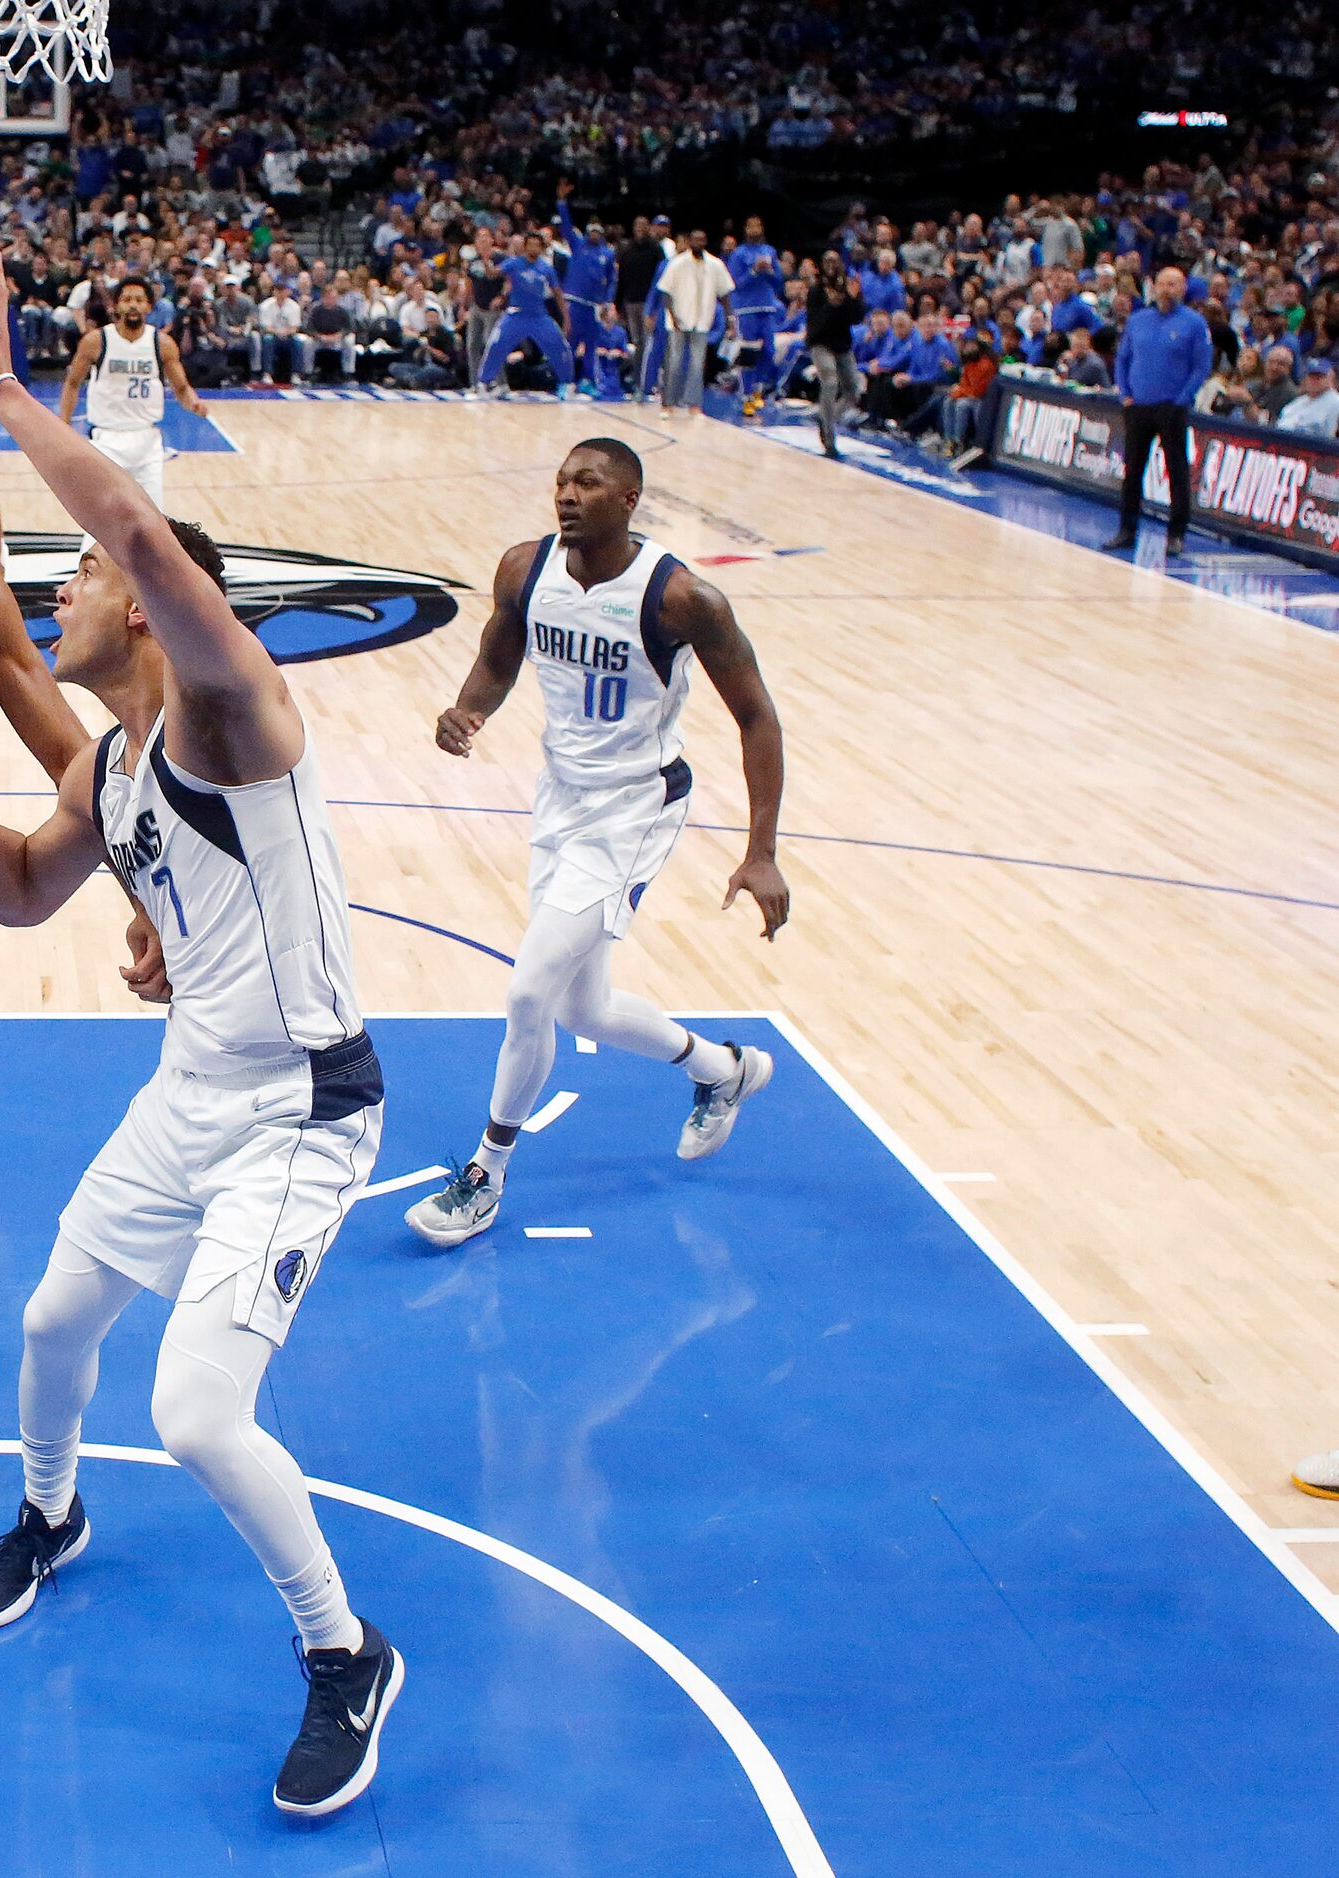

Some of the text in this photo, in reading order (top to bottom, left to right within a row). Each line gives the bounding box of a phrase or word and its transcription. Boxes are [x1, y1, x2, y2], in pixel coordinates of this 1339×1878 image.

[128, 377, 150, 398] 26
[1213, 444, 1307, 528] PLAYOFFS
[601, 602, 636, 618] chime
[534, 622, 630, 671] DALLAS
[582, 671, 628, 722] 10
[151, 866, 190, 938] 7
